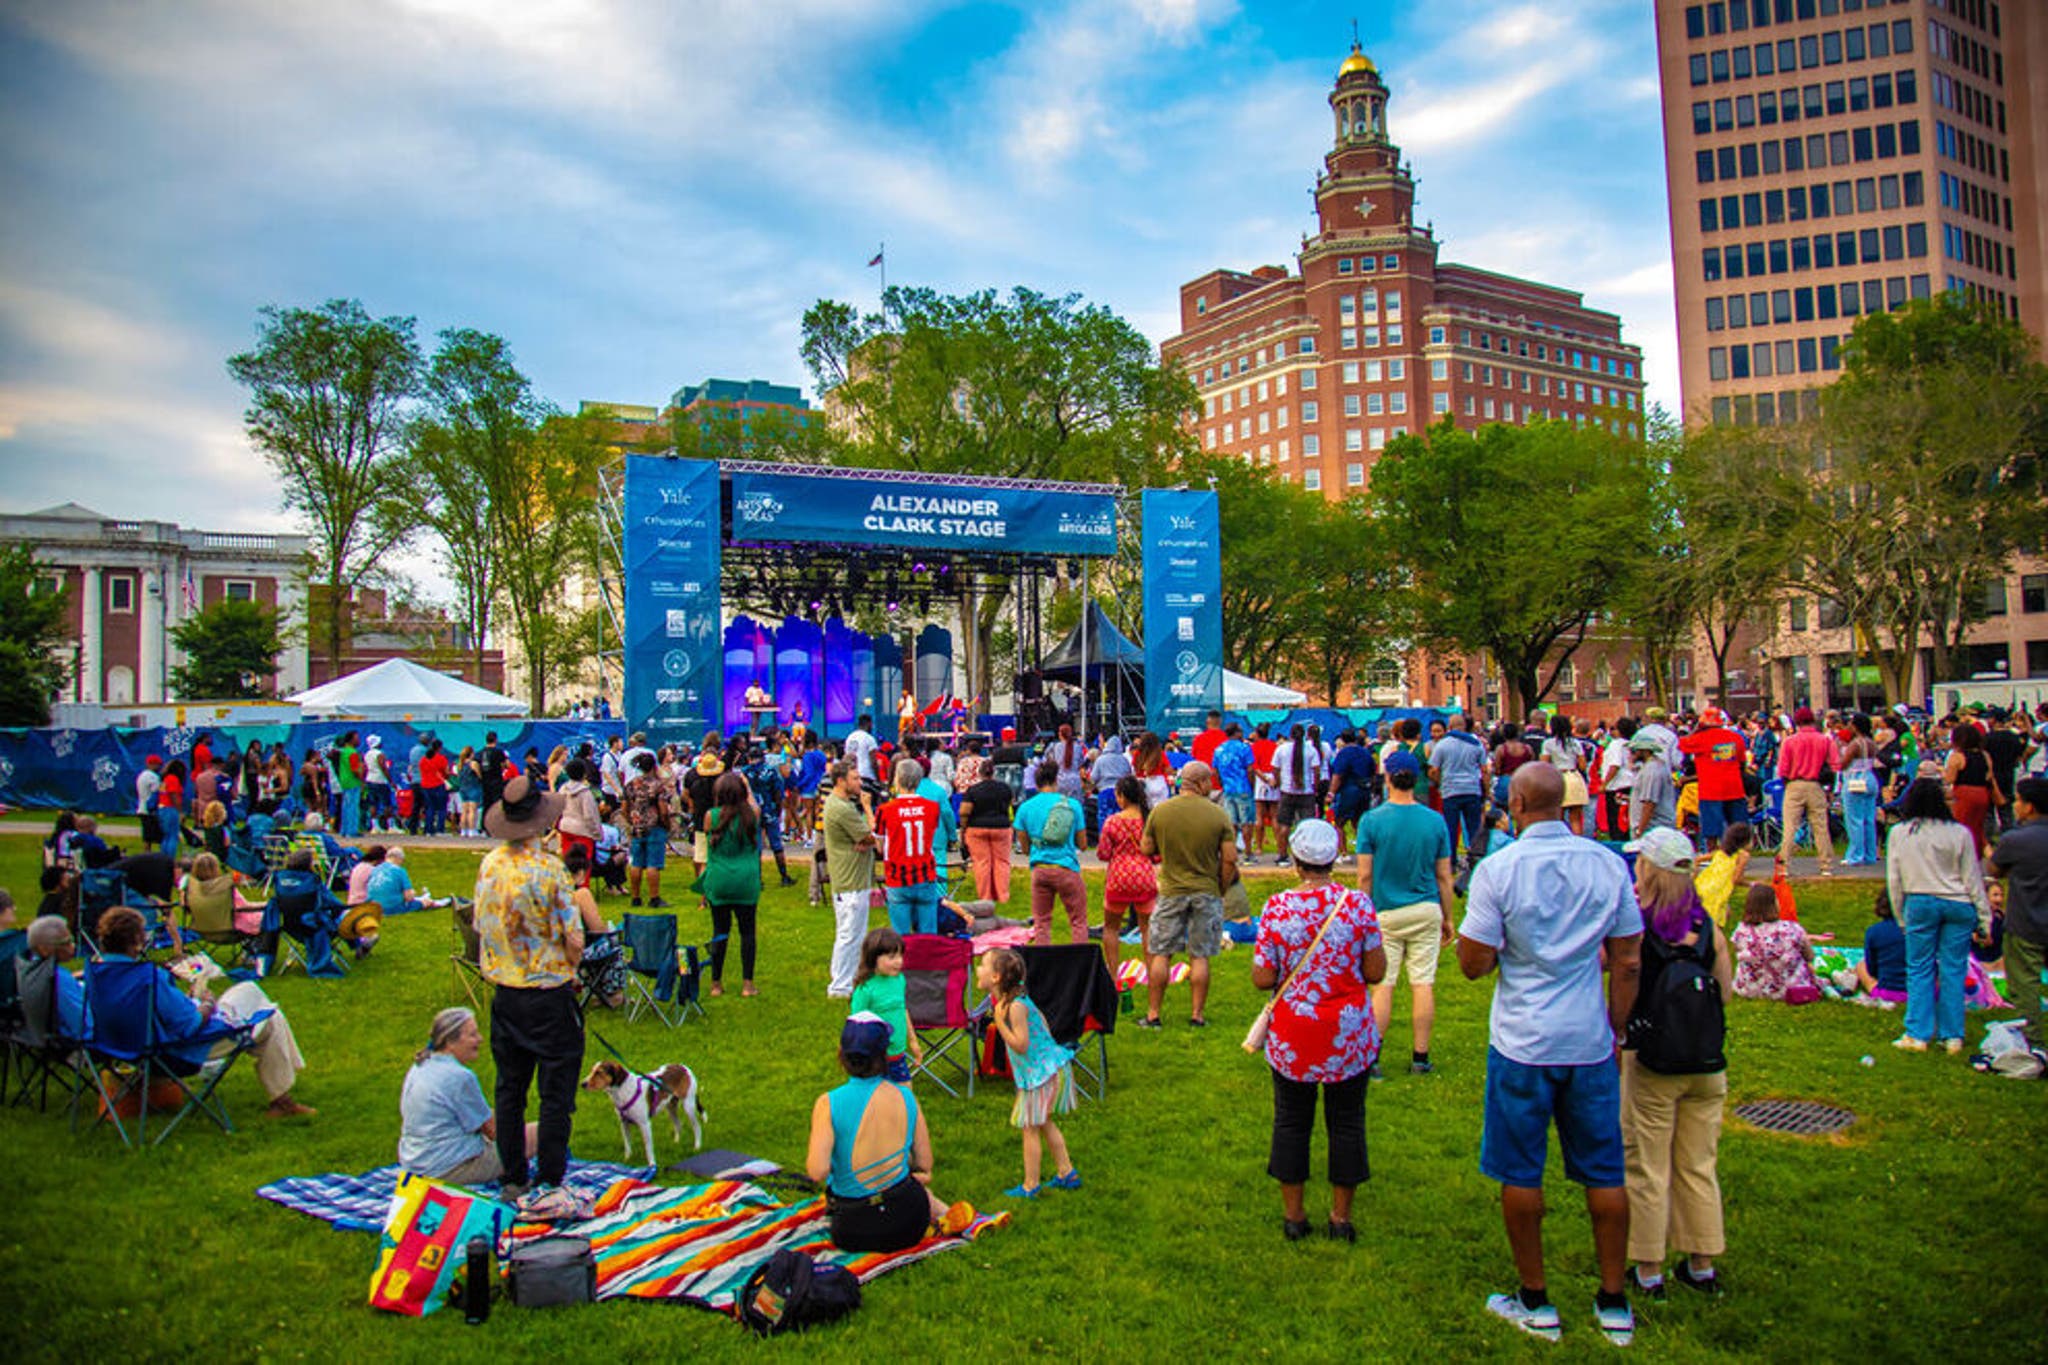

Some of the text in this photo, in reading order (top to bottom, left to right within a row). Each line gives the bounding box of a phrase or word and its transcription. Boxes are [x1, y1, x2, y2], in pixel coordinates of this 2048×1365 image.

[659, 488, 691, 504] Yale
[871, 495, 998, 517] ALEXANDER
[863, 515, 1007, 537] CLARK STAGE
[902, 820, 924, 856] 11
